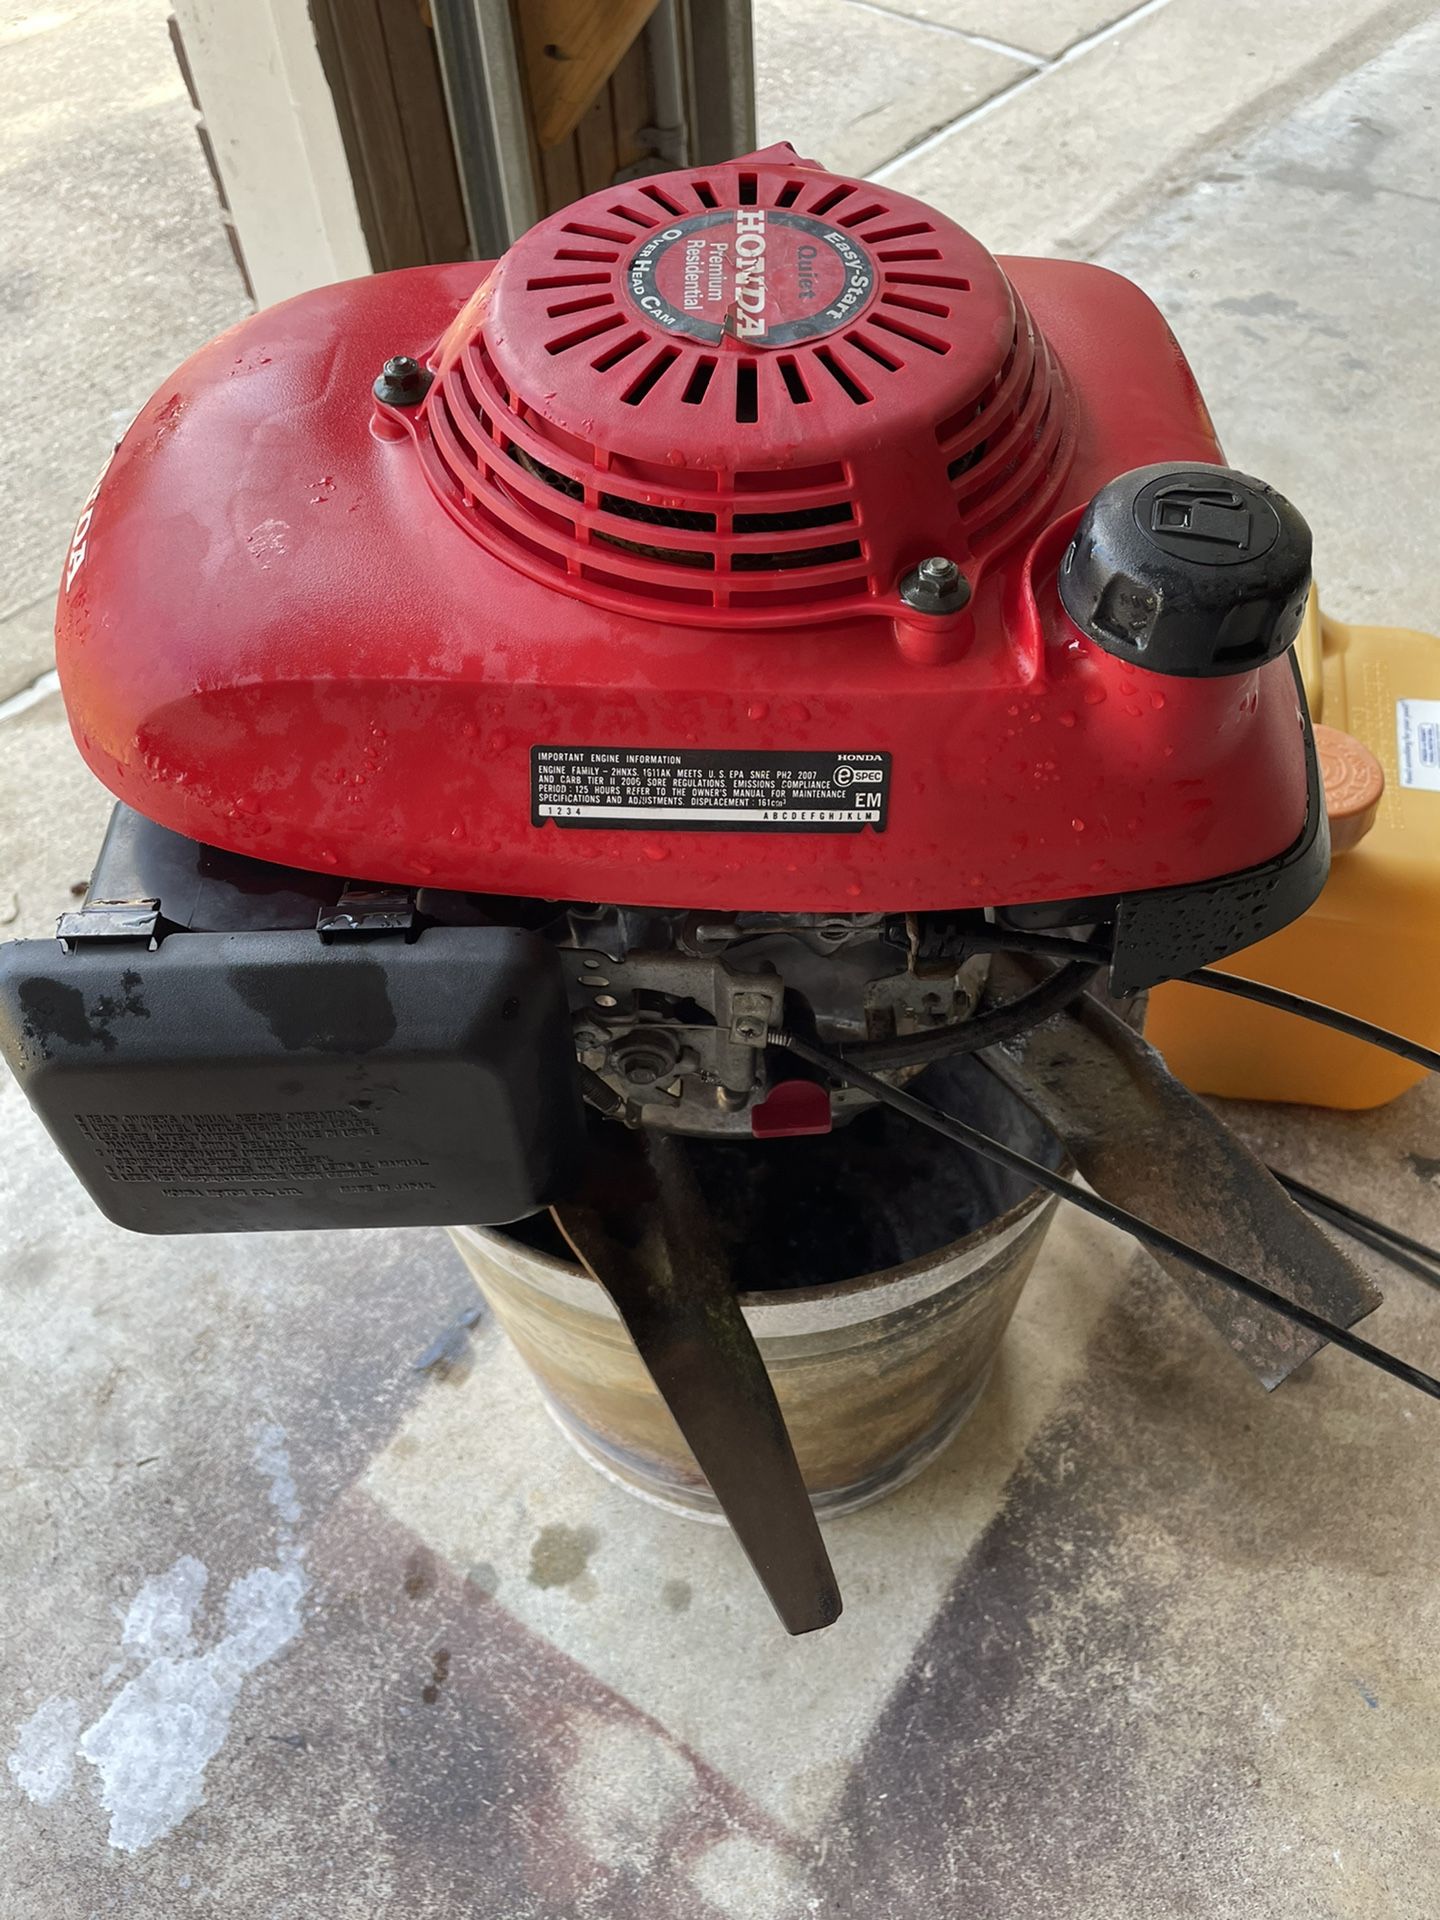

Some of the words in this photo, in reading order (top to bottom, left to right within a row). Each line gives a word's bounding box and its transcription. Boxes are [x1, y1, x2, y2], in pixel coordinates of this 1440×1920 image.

[631, 260, 653, 295] HEAD
[684, 239, 706, 310] Residential
[707, 242, 728, 302] Premium
[735, 209, 766, 338] HONDA
[797, 244, 818, 300] Quiet
[822, 231, 869, 320] Easy-Start
[640, 295, 676, 326] CAM
[538, 752, 584, 762] IMPORTANT
[590, 754, 620, 763] ENGINE
[626, 755, 682, 765] INFORMATION
[538, 765, 566, 775] ENGINE
[572, 766, 600, 775] FAMILY
[677, 769, 703, 778] MEETS
[729, 770, 744, 779] EPA
[750, 770, 771, 779] SNRE
[776, 770, 792, 779] PH2
[797, 770, 817, 780] 2007
[538, 775, 555, 784] AND
[560, 775, 582, 784] CARB
[587, 776, 604, 785] TIER
[647, 778, 666, 787] SORE
[673, 778, 727, 788] REGULATIONS.
[733, 779, 776, 789] EMISSIONS
[782, 780, 831, 790] COMPLIANCE
[855, 772, 881, 781] SPEC
[538, 793, 601, 804] SPECIFICATIONS
[606, 795, 623, 804] AND
[575, 785, 589, 794] 125
[594, 786, 621, 795] HOURS
[626, 786, 650, 796] REFER
[656, 787, 666, 796] TO
[672, 787, 686, 797] THE
[692, 788, 728, 798] OWNER'S
[733, 788, 765, 798] MANUAL
[771, 789, 786, 798] FOR
[792, 789, 846, 799] MAINTENANCE
[855, 792, 882, 808] EM
